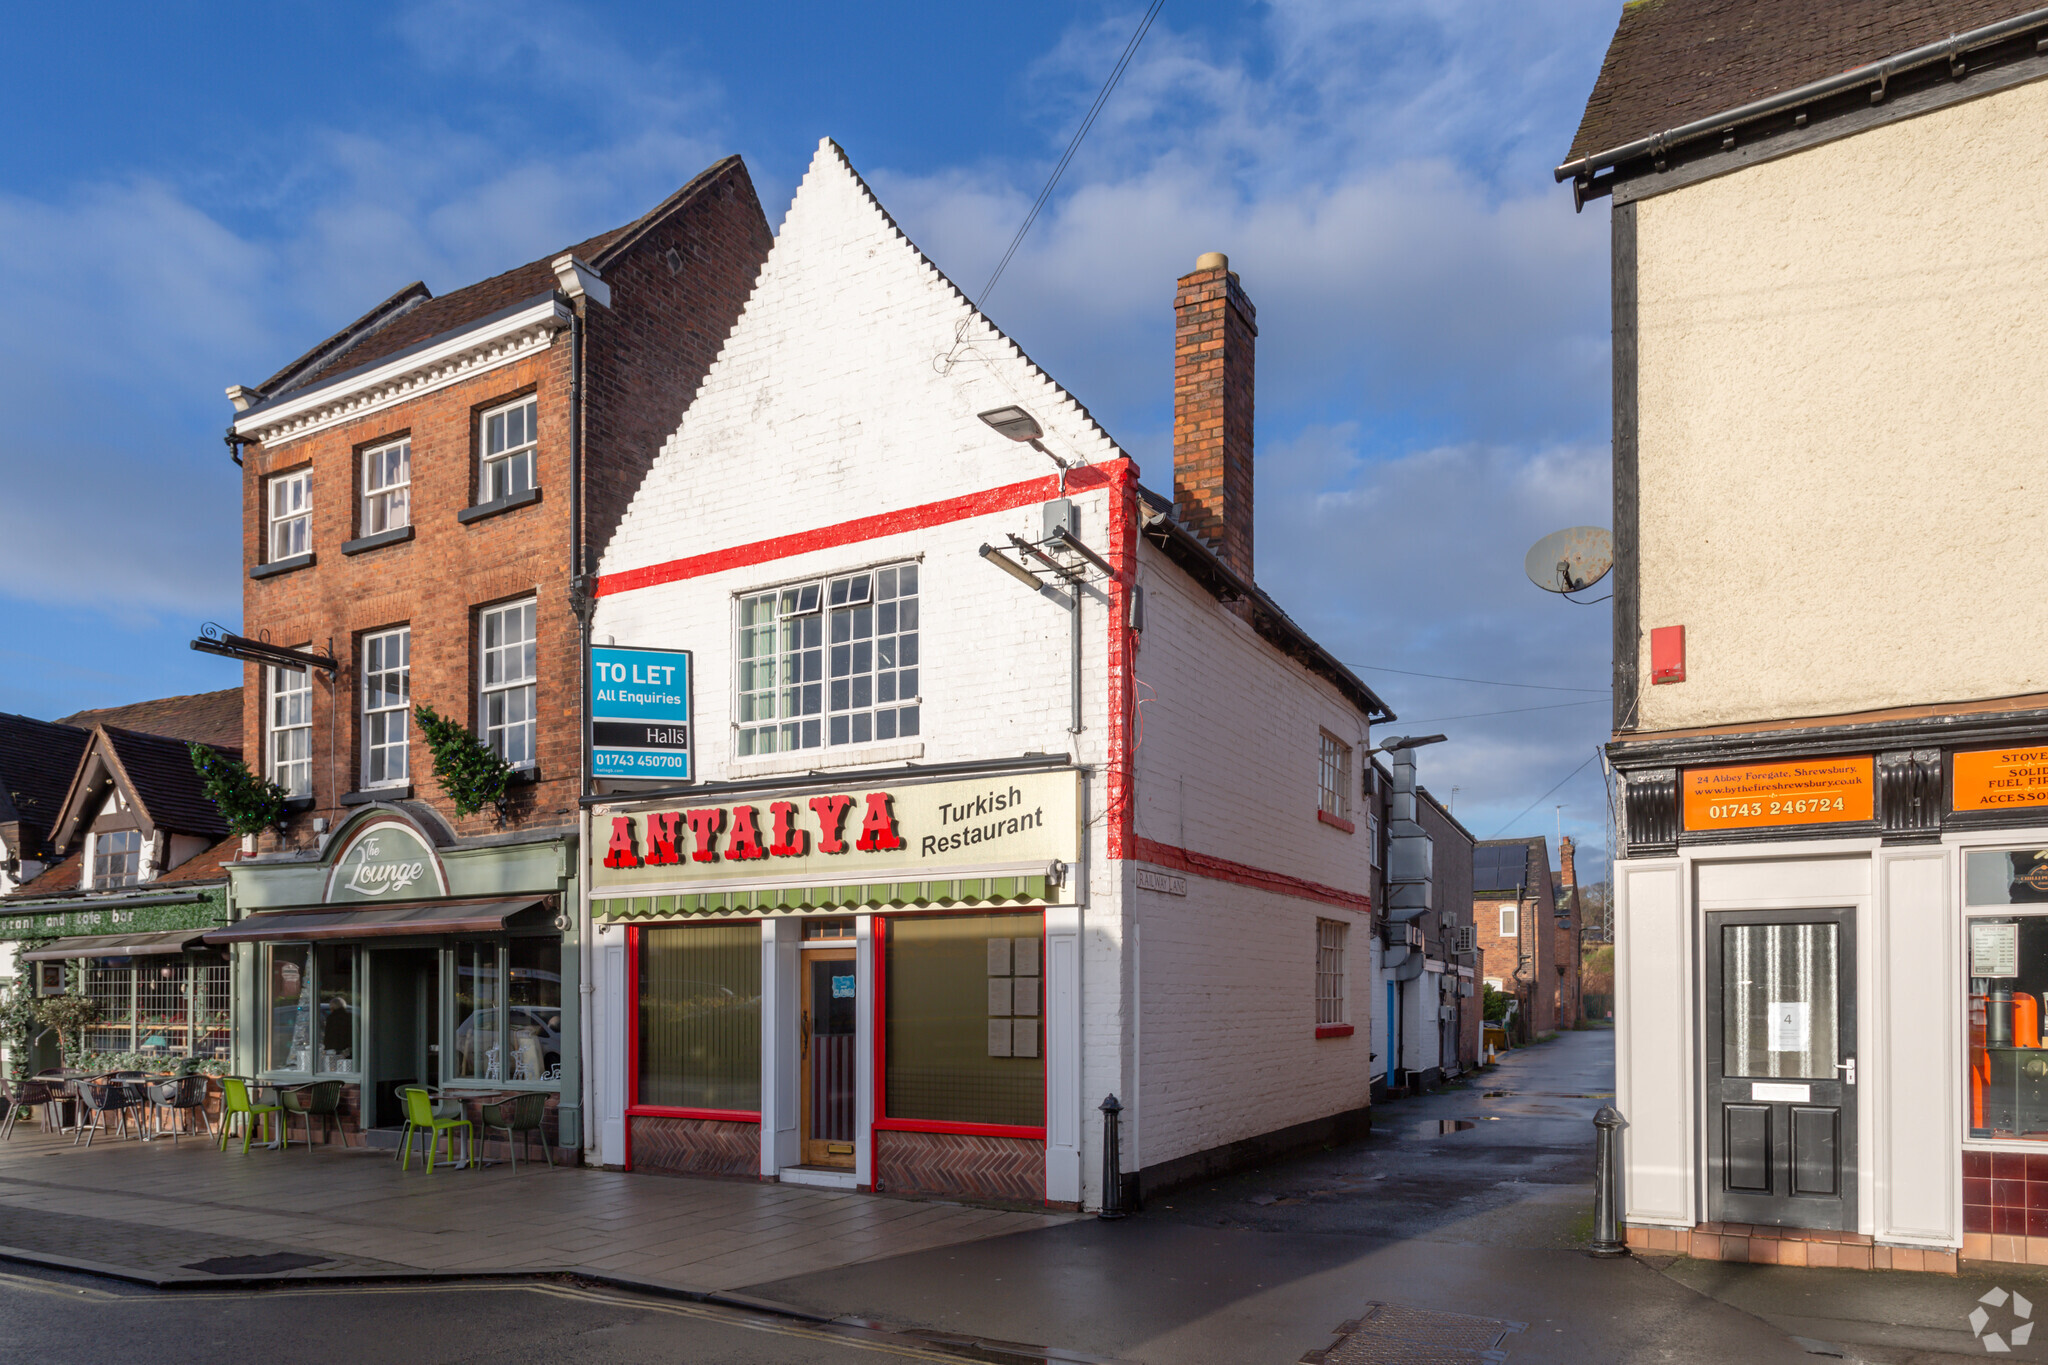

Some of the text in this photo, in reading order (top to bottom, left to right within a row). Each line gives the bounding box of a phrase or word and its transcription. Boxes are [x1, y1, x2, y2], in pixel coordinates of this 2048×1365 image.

[596, 662, 675, 685] TO LET
[597, 689, 681, 705] All Enquiries
[646, 728, 684, 744] Halls
[596, 754, 682, 767] 01743 450700
[1697, 766, 1857, 784] 24 Abbey Foregate, Shrewsbury.
[1989, 779, 2023, 788] FUEL
[1694, 777, 1862, 795] www.bythefireshrewsbury.co.uk
[939, 786, 1021, 825] Turkish
[1980, 792, 2048, 804] ACCESSO
[1709, 797, 1844, 819] 01743 246724
[603, 791, 907, 870] ANTALYA
[922, 806, 1042, 857] Restaurant
[364, 838, 380, 861] The
[344, 846, 424, 896] Lounge
[46, 913, 65, 927] and
[77, 911, 101, 925] cafe
[111, 909, 134, 923] bar
[1784, 1014, 1792, 1025] 4
